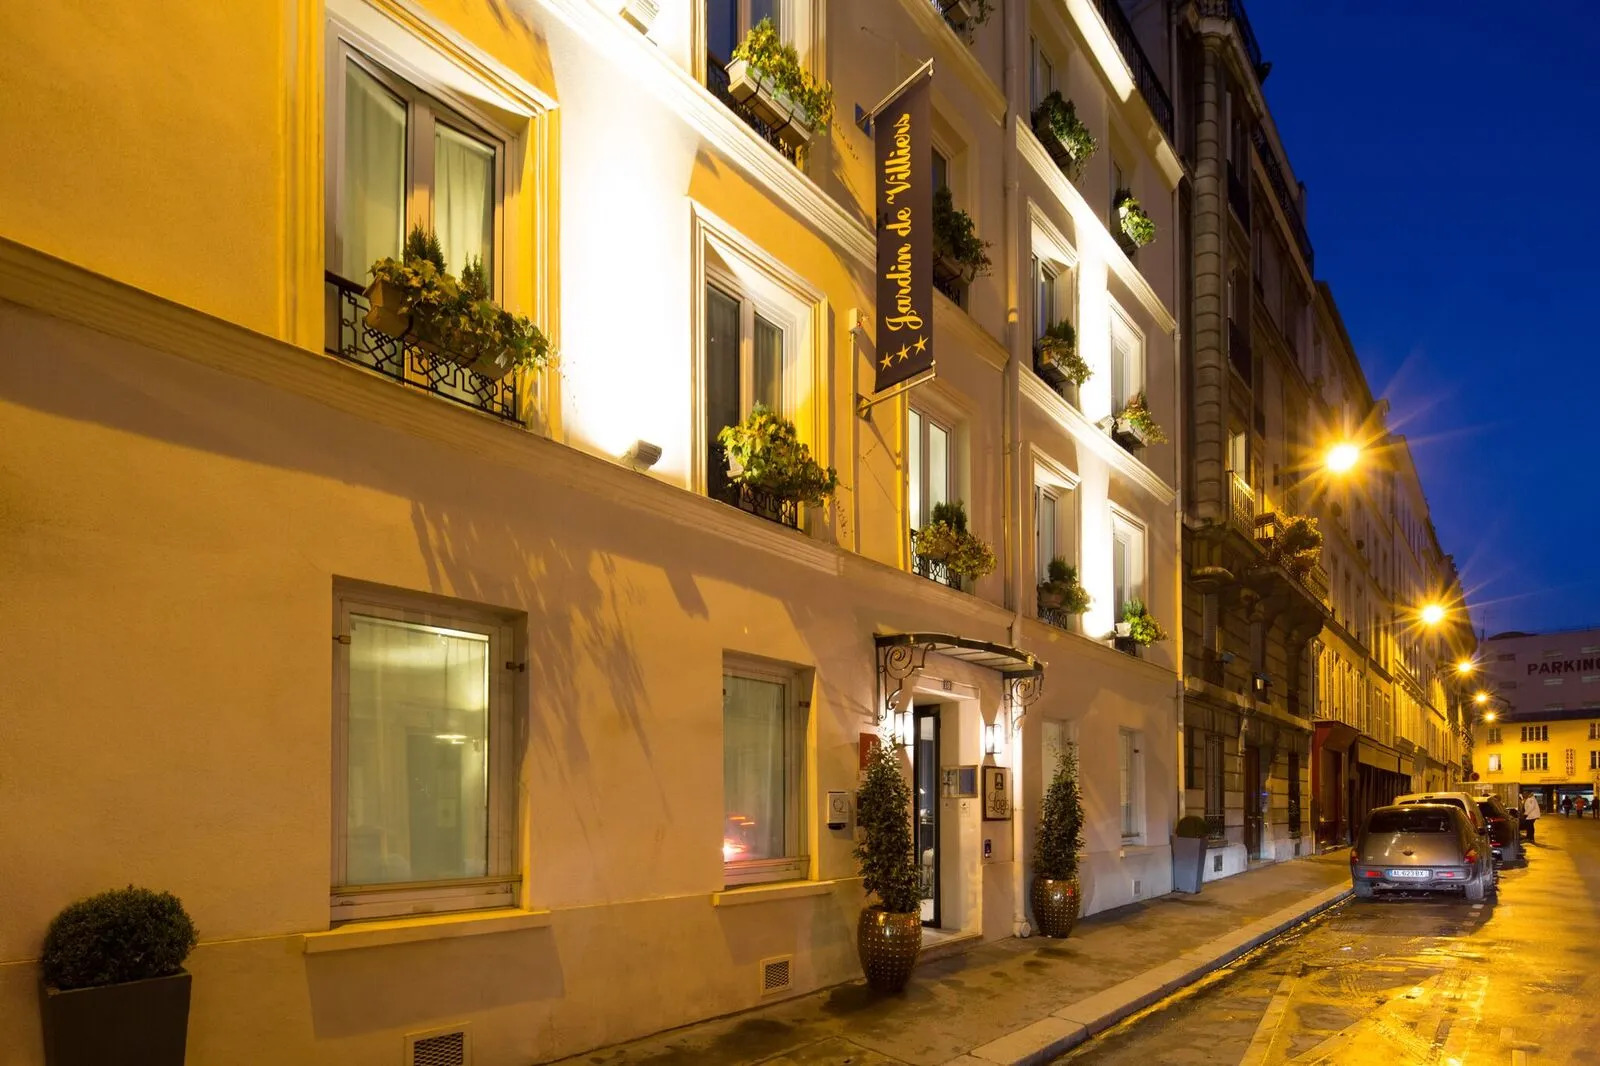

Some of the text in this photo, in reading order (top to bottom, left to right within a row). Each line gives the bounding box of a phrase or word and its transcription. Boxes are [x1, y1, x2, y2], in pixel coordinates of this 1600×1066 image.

[886, 113, 923, 332] Jardin de Villiers
